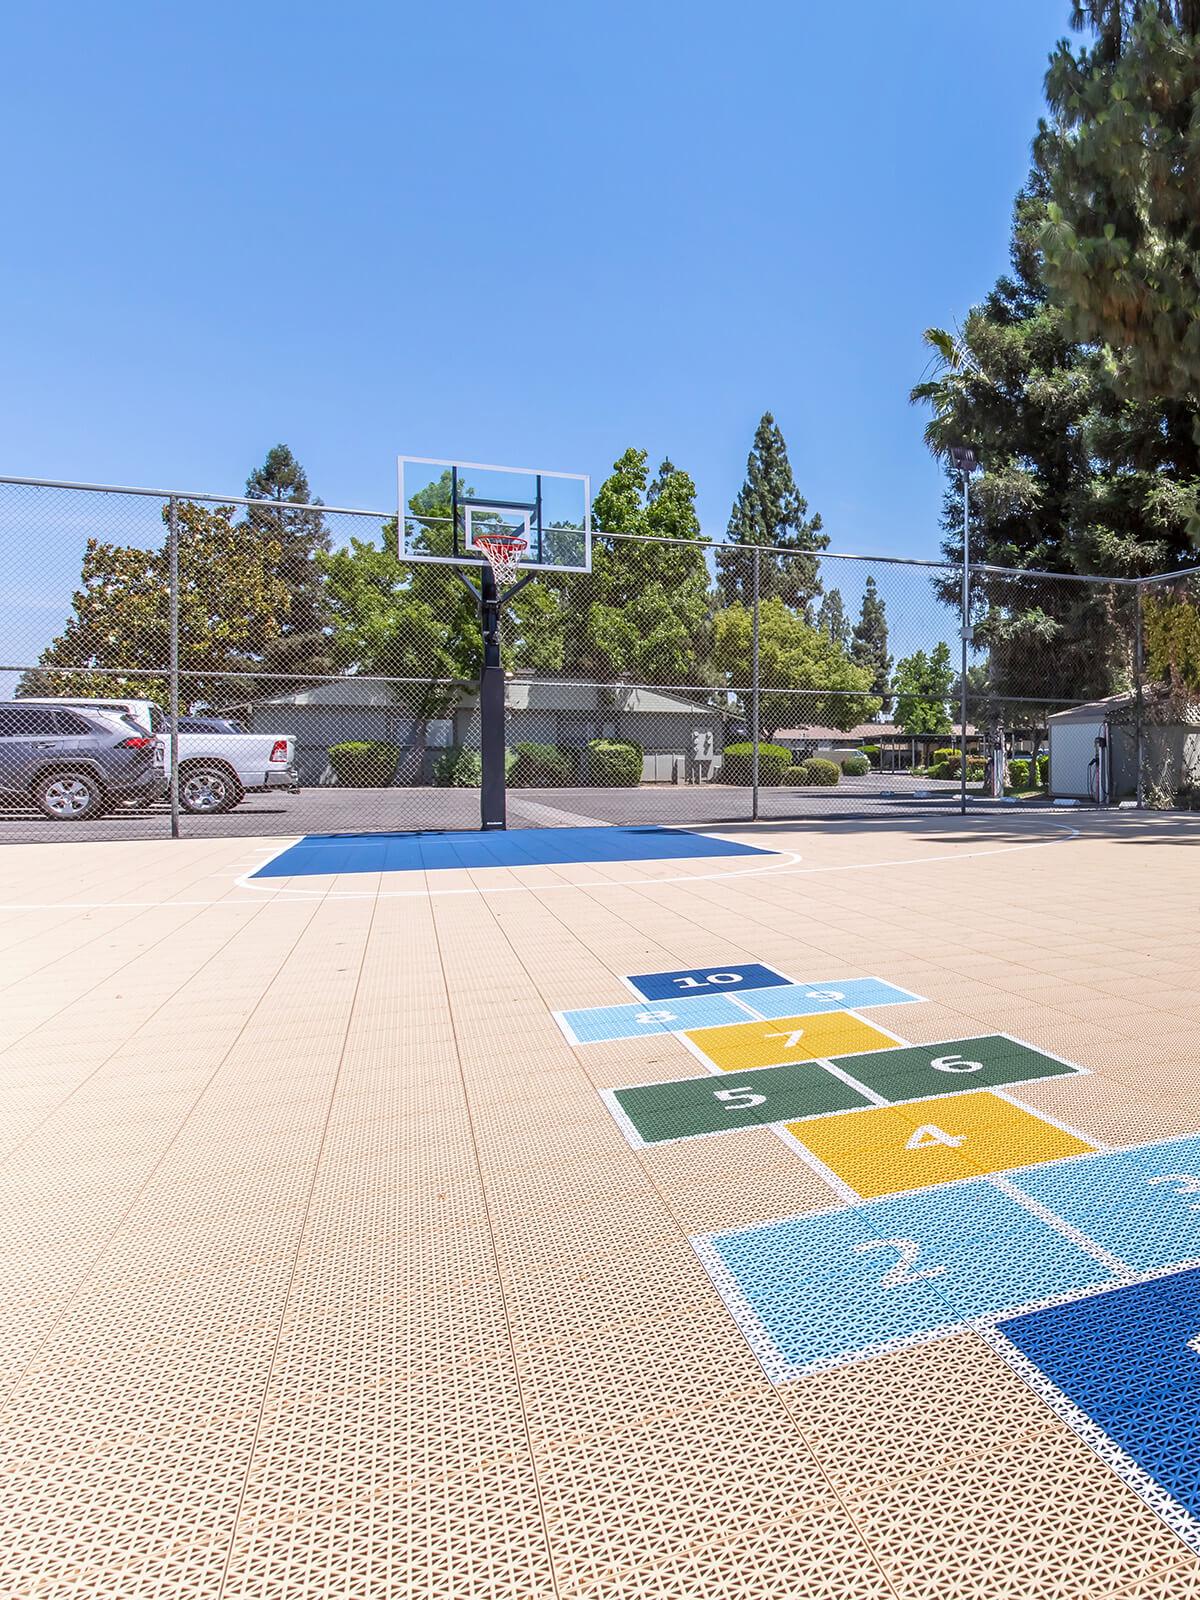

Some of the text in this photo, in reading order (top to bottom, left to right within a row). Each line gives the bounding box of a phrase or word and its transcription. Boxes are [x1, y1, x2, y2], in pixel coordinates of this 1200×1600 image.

[672, 973, 744, 989] 10
[805, 990, 845, 1002] 9
[635, 1011, 678, 1024] 8
[764, 1028, 806, 1048] 7
[930, 1054, 984, 1074] 6
[713, 1087, 767, 1111] 5
[904, 1124, 967, 1151] 4
[852, 1238, 948, 1289] 2
